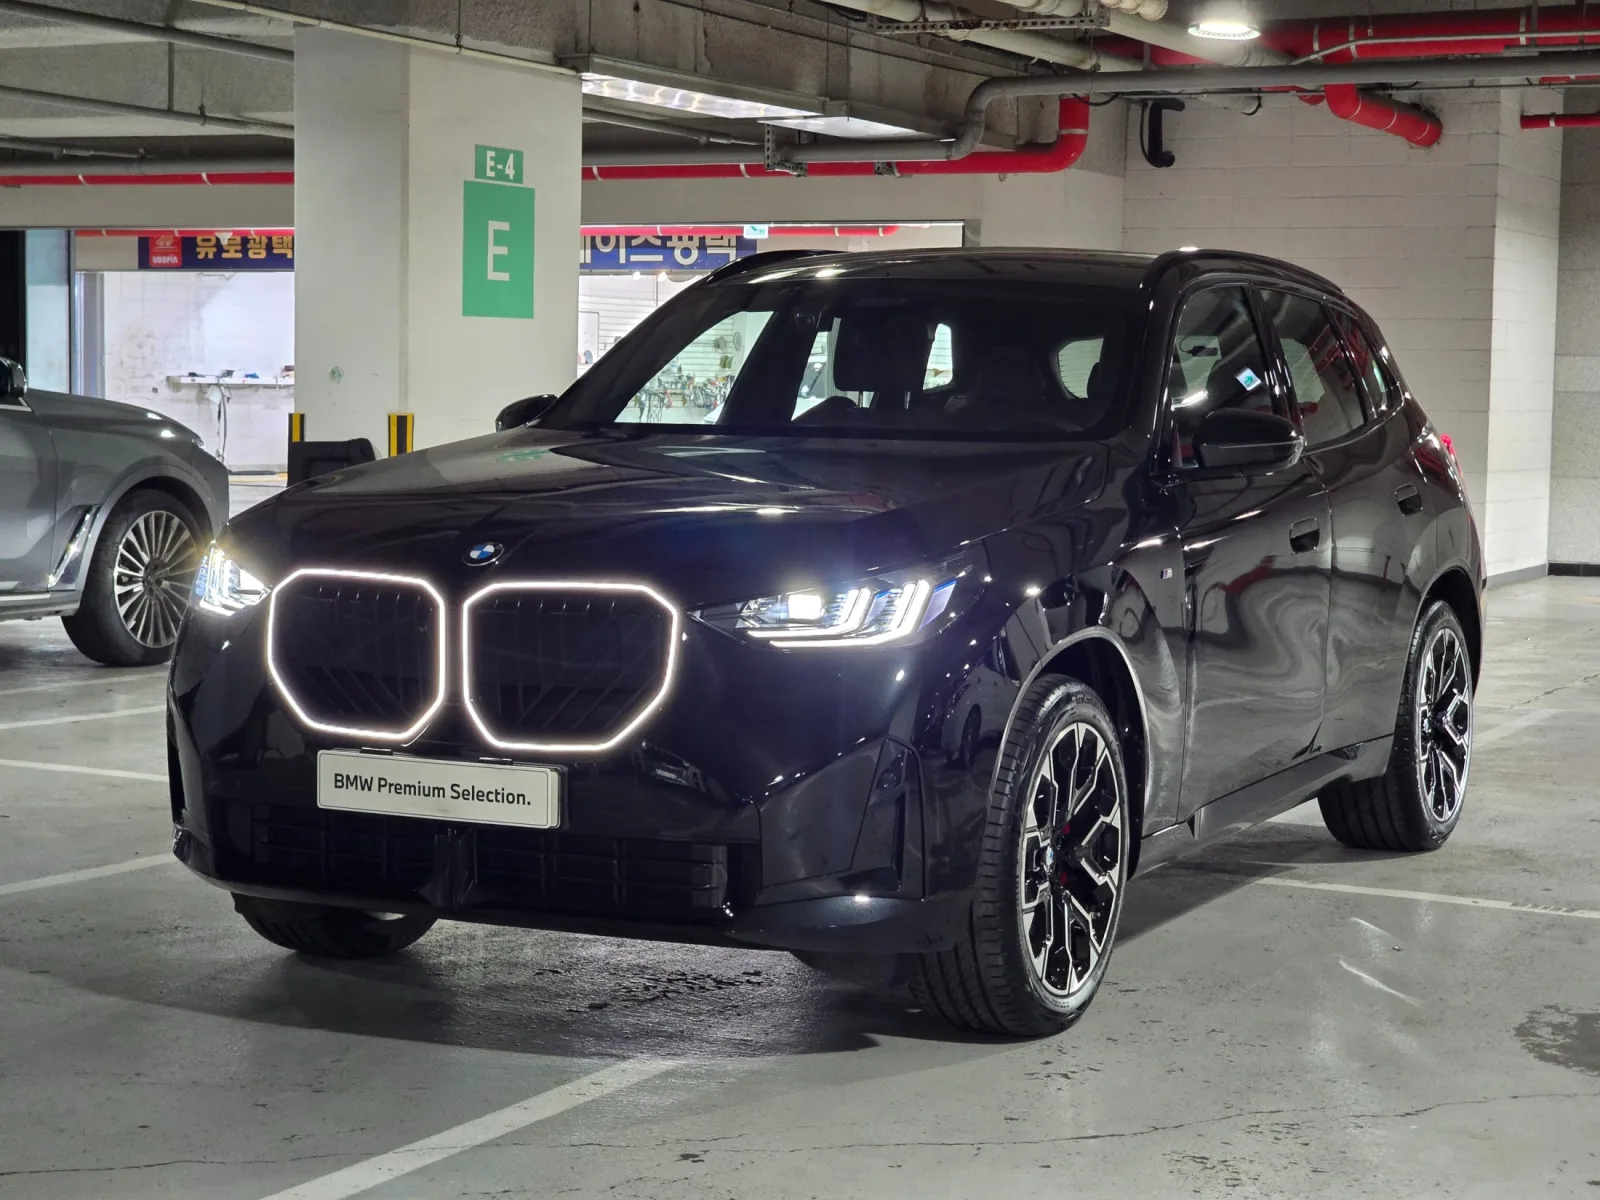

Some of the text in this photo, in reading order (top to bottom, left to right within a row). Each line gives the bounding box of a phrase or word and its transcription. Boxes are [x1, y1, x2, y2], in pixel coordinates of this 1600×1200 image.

[486, 151, 515, 180] E-4
[487, 220, 510, 281] E
[334, 773, 531, 806] BMW Premium Selection.
